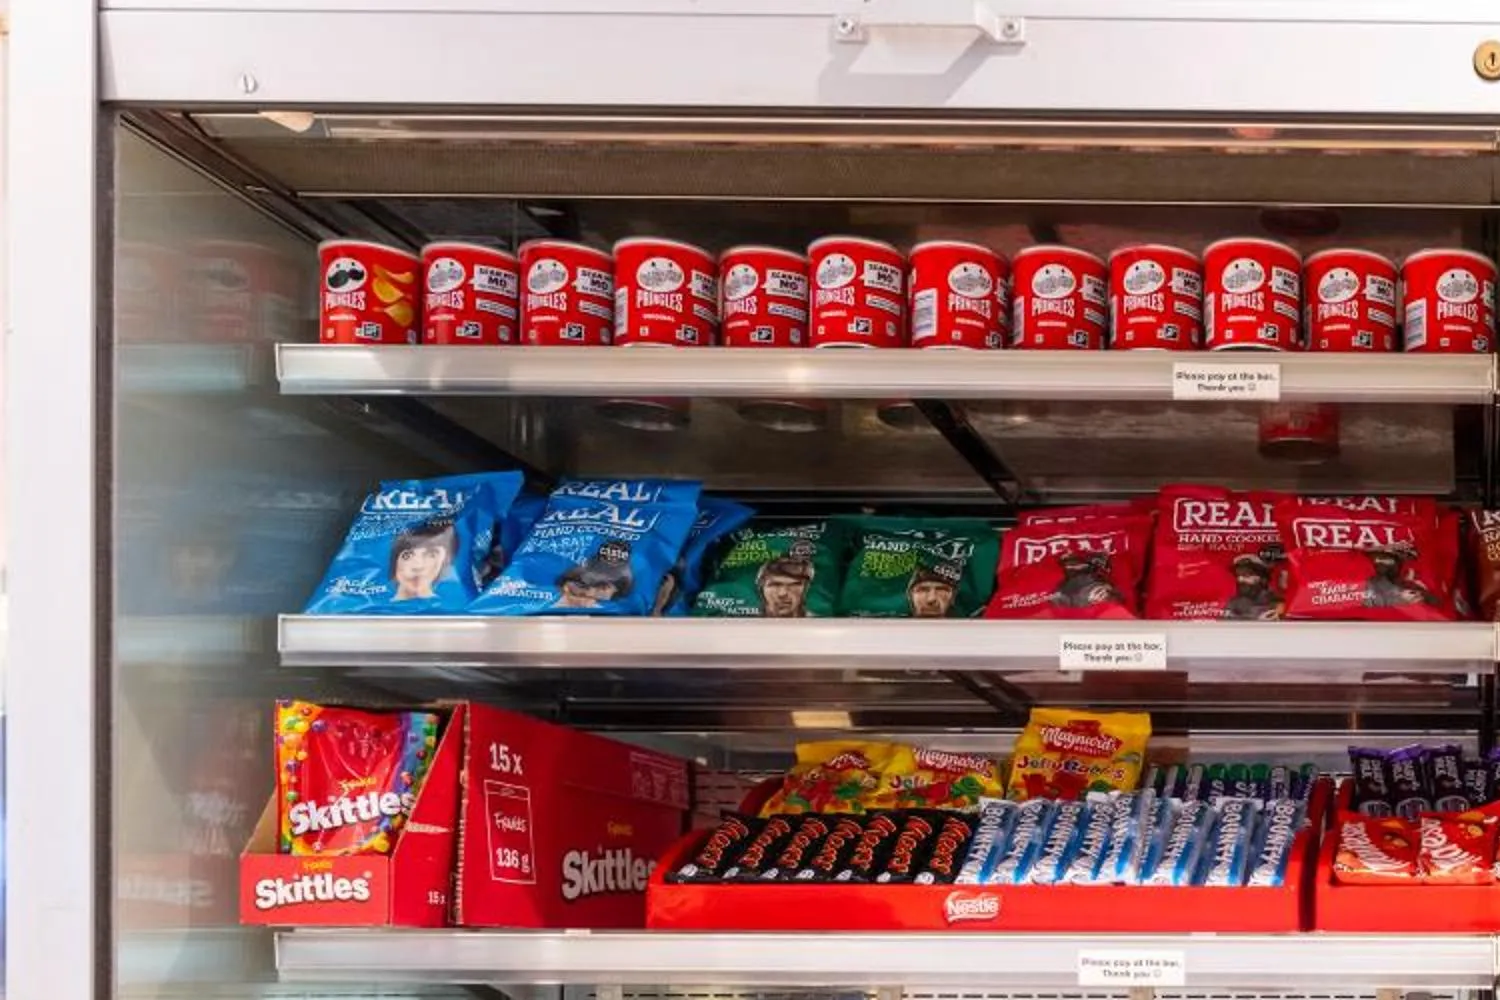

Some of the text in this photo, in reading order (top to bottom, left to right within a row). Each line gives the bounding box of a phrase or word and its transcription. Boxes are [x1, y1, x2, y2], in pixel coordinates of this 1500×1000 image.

[636, 290, 683, 313] PRINGLES
[1032, 298, 1075, 317] PRINGLES
[1123, 294, 1165, 314] PRINGLES
[1222, 291, 1264, 312] PRINGLES
[1318, 300, 1358, 321] PRINGLES
[1437, 303, 1479, 321] PRINGLES
[1208, 373, 1226, 382] pay
[1240, 372, 1254, 380] the
[553, 481, 650, 501] REAL
[544, 502, 645, 527] REAL
[533, 525, 640, 541] HAND COOKED
[1178, 534, 1219, 543] HAND
[1303, 523, 1405, 549] REAL
[1064, 642, 1092, 650] Please
[1095, 643, 1112, 652] pay
[1115, 642, 1125, 650] at
[1128, 642, 1141, 650] the
[1084, 654, 1131, 664] Thank you
[289, 792, 415, 834] Skittles
[494, 811, 527, 832] Fruits
[972, 805, 1006, 862] BOUNTY
[1048, 804, 1079, 866] BOUNTY
[1219, 801, 1244, 863] BOUNTY
[1265, 798, 1296, 863] BOUNTY
[256, 874, 371, 909] Skittles
[945, 892, 998, 921] Nestlé
